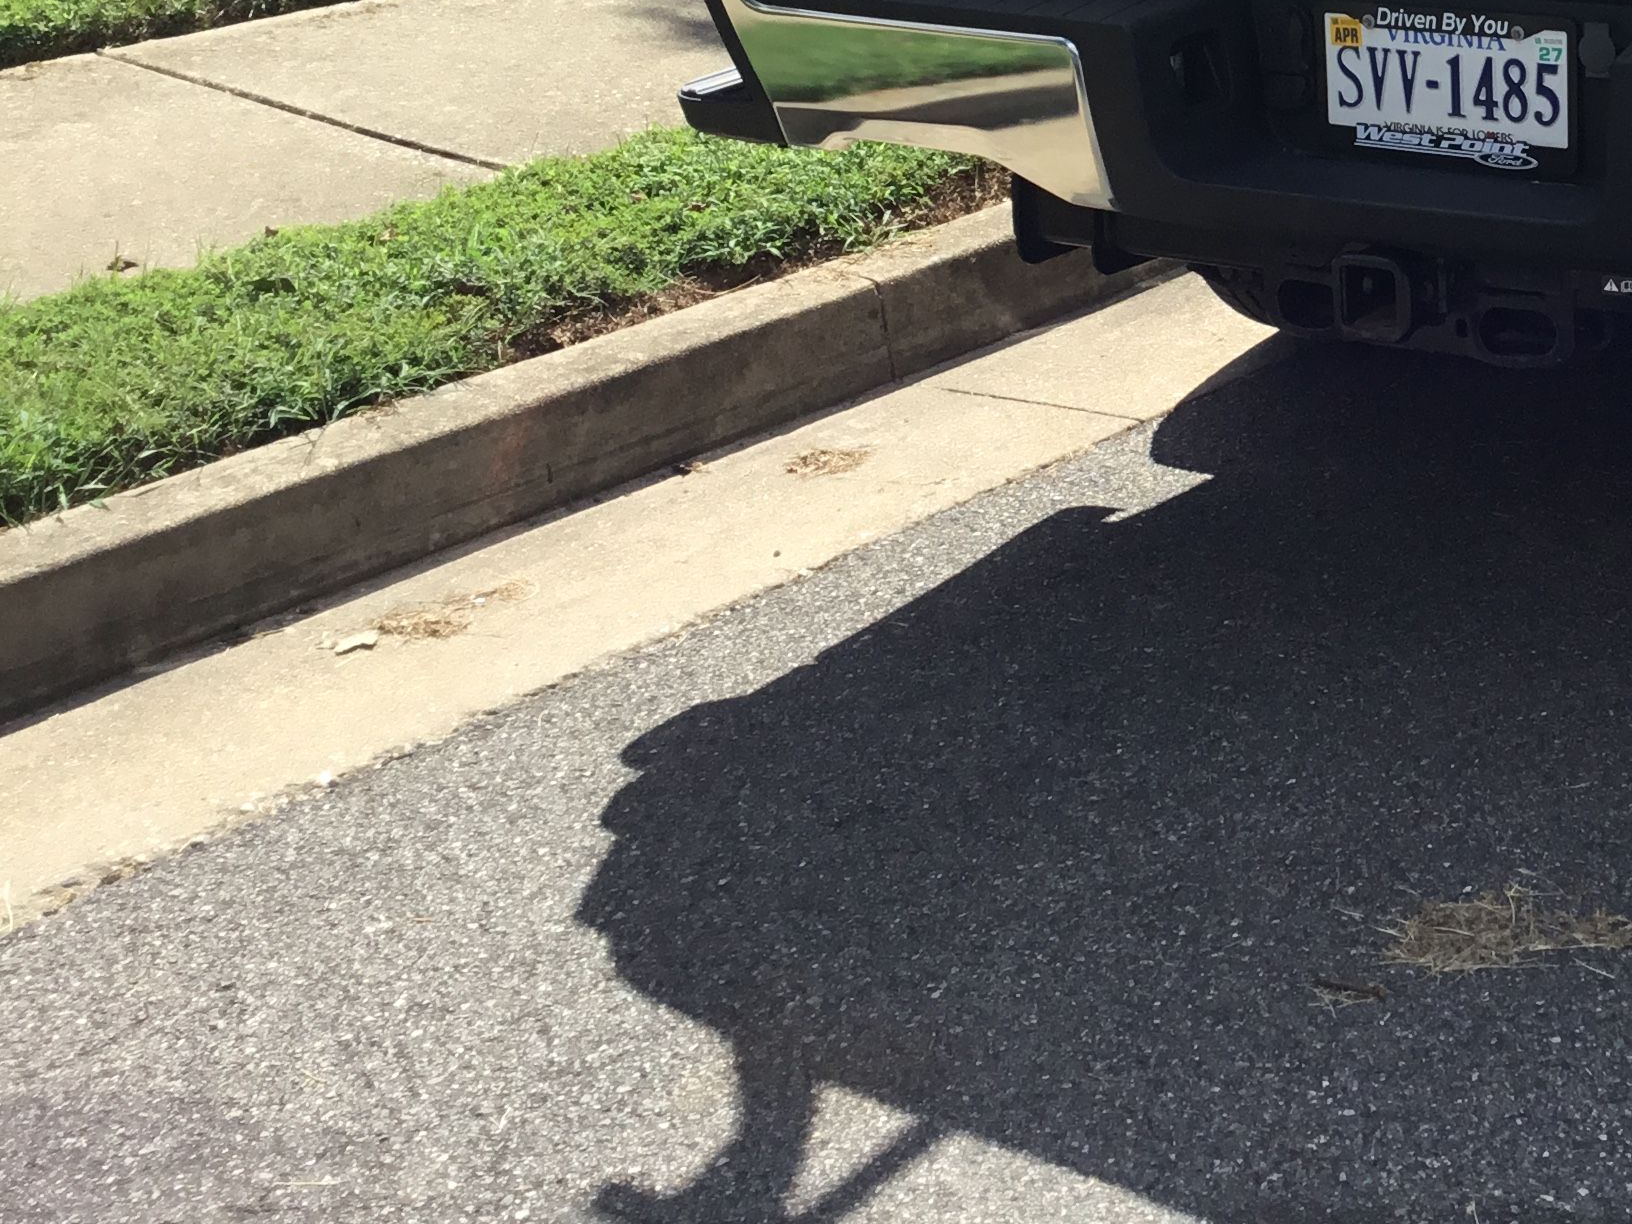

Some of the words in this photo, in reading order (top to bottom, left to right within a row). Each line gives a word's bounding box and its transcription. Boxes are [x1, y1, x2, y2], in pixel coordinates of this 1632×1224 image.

[1376, 7, 1437, 30] Driven
[1442, 12, 1466, 35] By
[1471, 14, 1509, 36] You
[1334, 27, 1359, 44] APR
[1387, 27, 1506, 52] VIRGINIA
[1538, 46, 1563, 62] 27
[1336, 44, 1561, 128] SVV-1485
[1384, 121, 1434, 136] VIRGINIA
[1435, 125, 1445, 135] IS
[1355, 123, 1440, 147] West
[1440, 134, 1529, 156] Point
[1487, 152, 1524, 166] Ford
